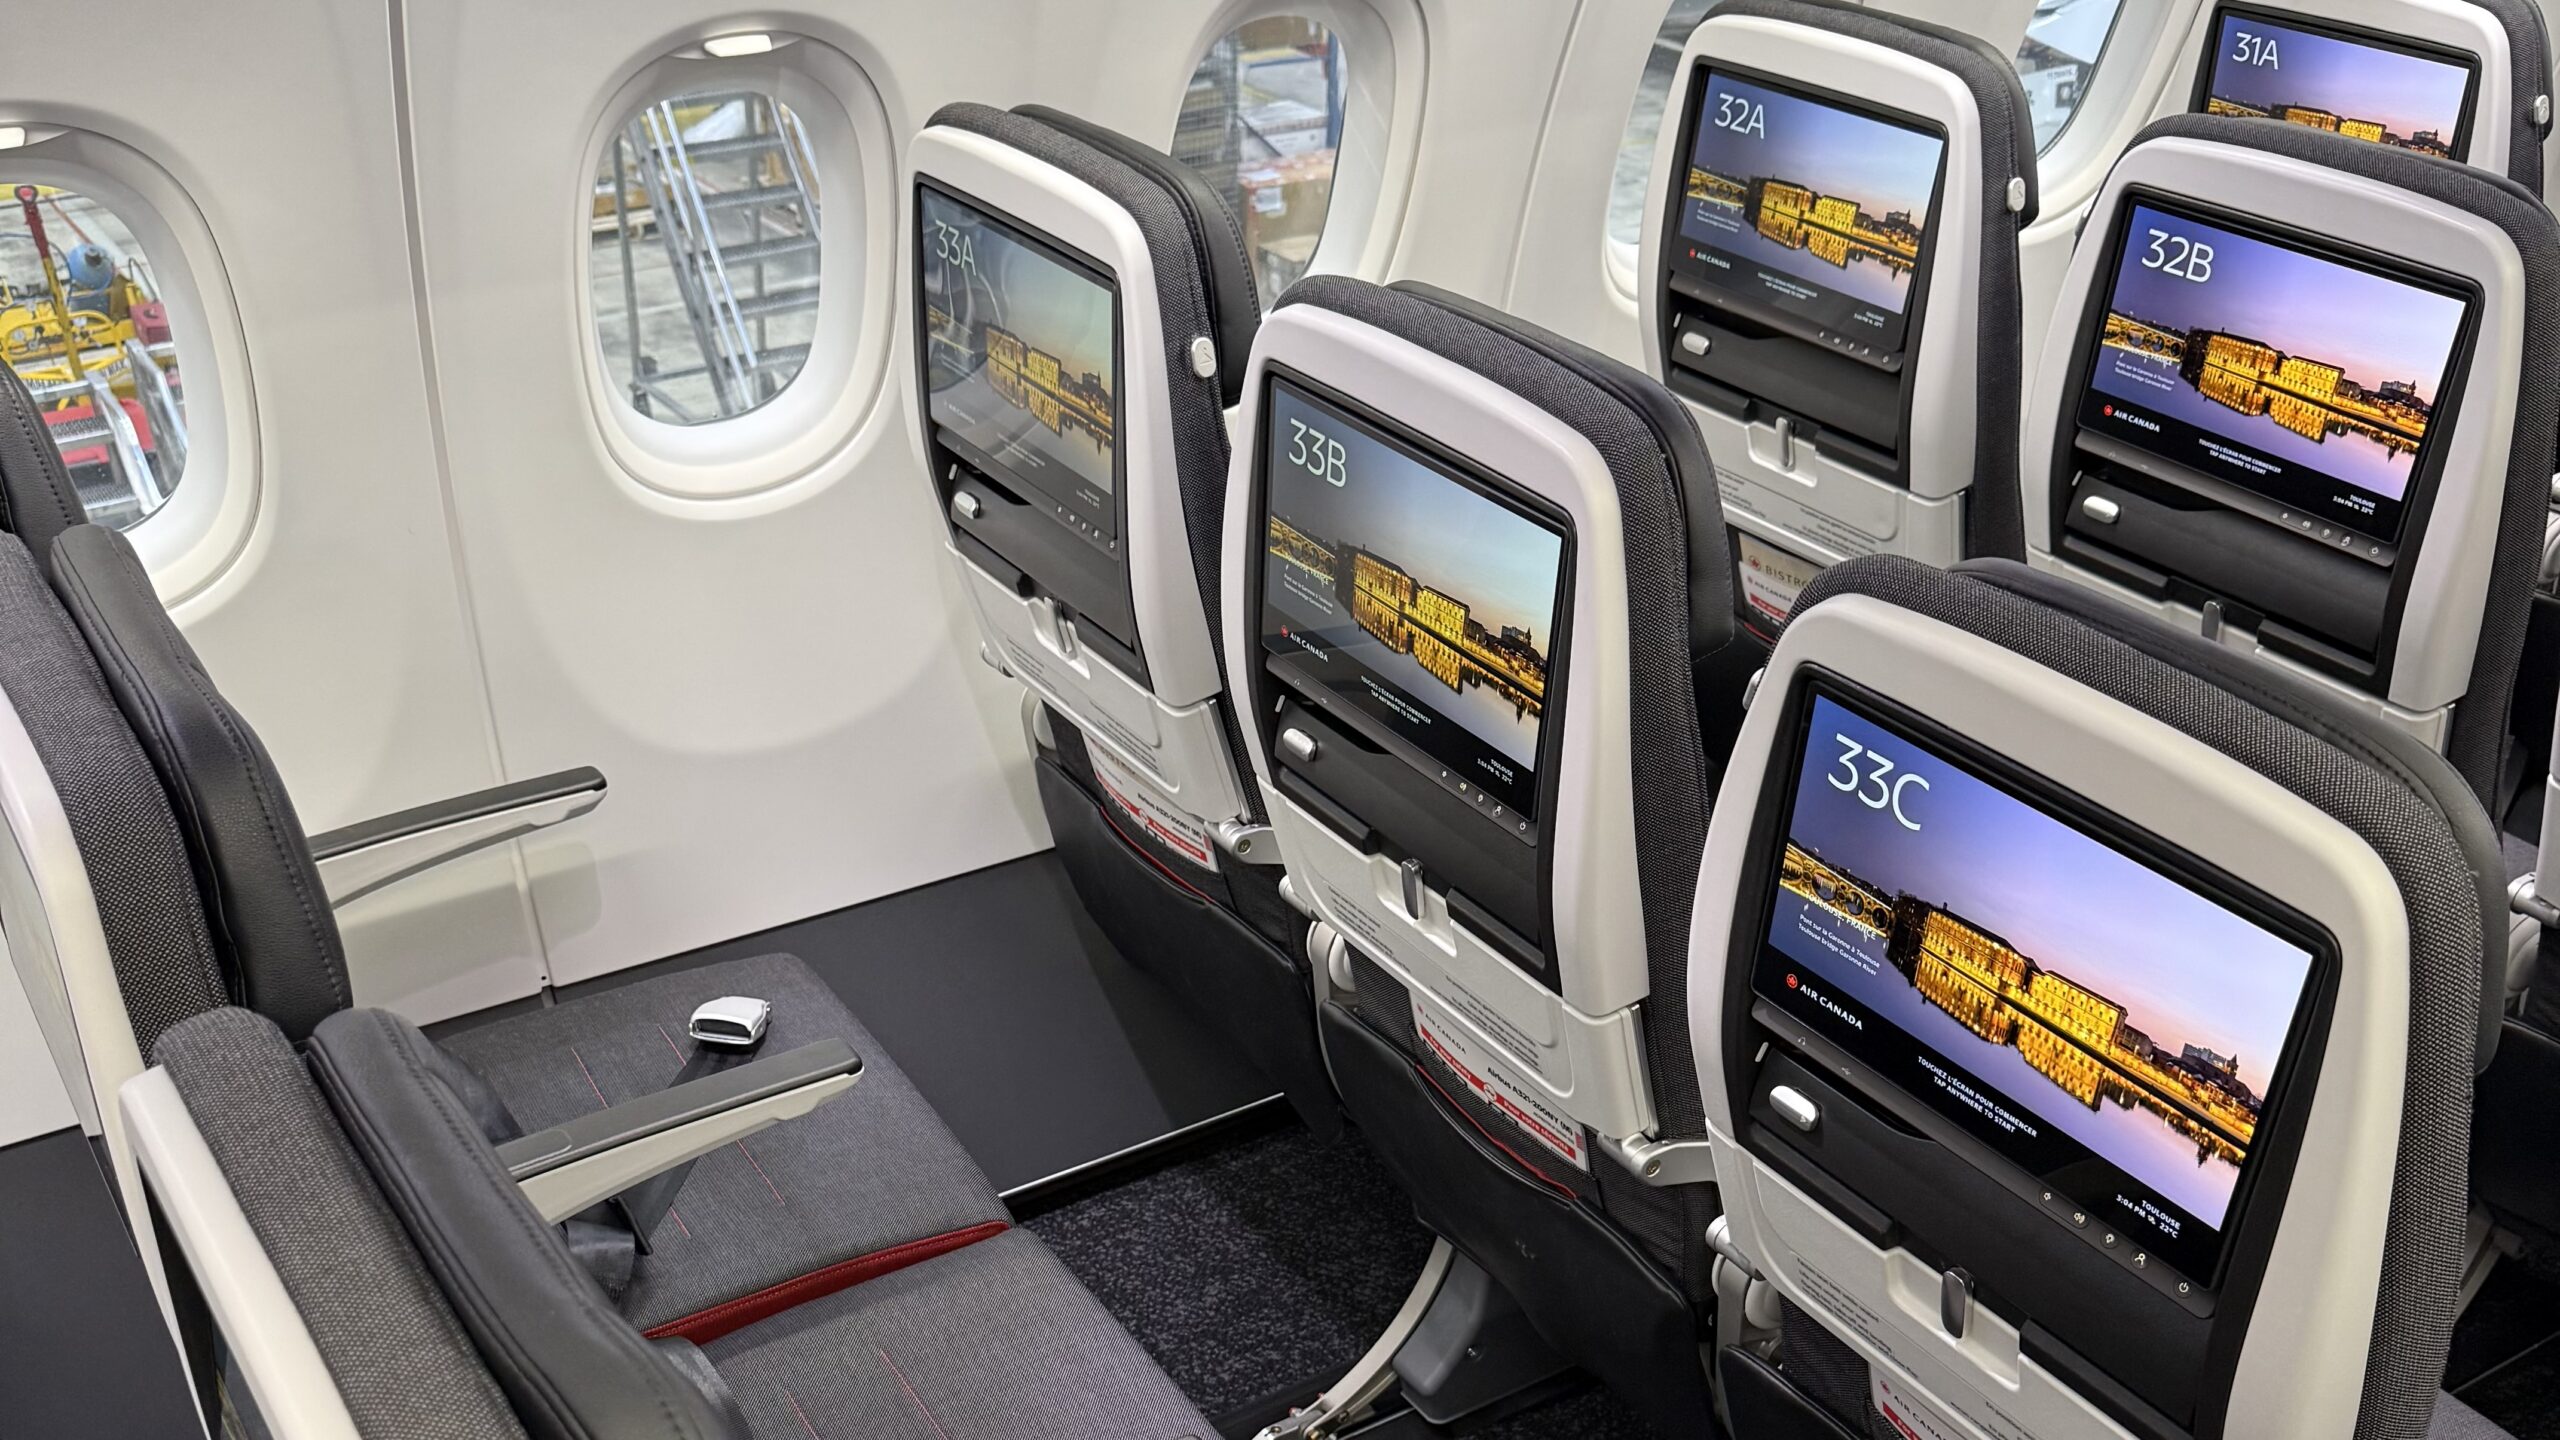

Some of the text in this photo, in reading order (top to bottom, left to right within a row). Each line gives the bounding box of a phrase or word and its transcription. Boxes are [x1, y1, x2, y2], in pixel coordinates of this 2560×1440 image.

[2232, 31, 2279, 70] 31A
[1714, 93, 1765, 139] 32A
[934, 219, 977, 277] 33A
[2141, 228, 2214, 283] 32B
[2113, 409, 2160, 433] AIR CANADA
[1288, 417, 1347, 488] 33B
[1290, 632, 1329, 662] AIR CANADA
[1827, 732, 1930, 831] 33C
[1798, 922, 1877, 976] Toulouse bridge Garonne River
[1799, 913, 1812, 928] Pont
[1813, 921, 1822, 932] sur
[1828, 931, 1851, 951] Garonne
[1856, 948, 1880, 969] Toulouse
[1846, 917, 1877, 941] FRANCE
[1800, 984, 1863, 1030] AIR CANADA
[1437, 1024, 1467, 1055] CANADA
[1487, 1066, 1511, 1089] Airbus
[1918, 1055, 2037, 1137] TOUCHEZ L'ÉCRAN POUR COMMENCER
[1933, 1076, 2016, 1133] TAP ANYWHERE TO START
[2116, 1193, 2179, 1239] 3:04 PM 22°C
[2141, 1199, 2181, 1230] TOULOUSE
[1894, 1395, 1911, 1414] AIR
[1912, 1413, 1946, 1440] CANA
